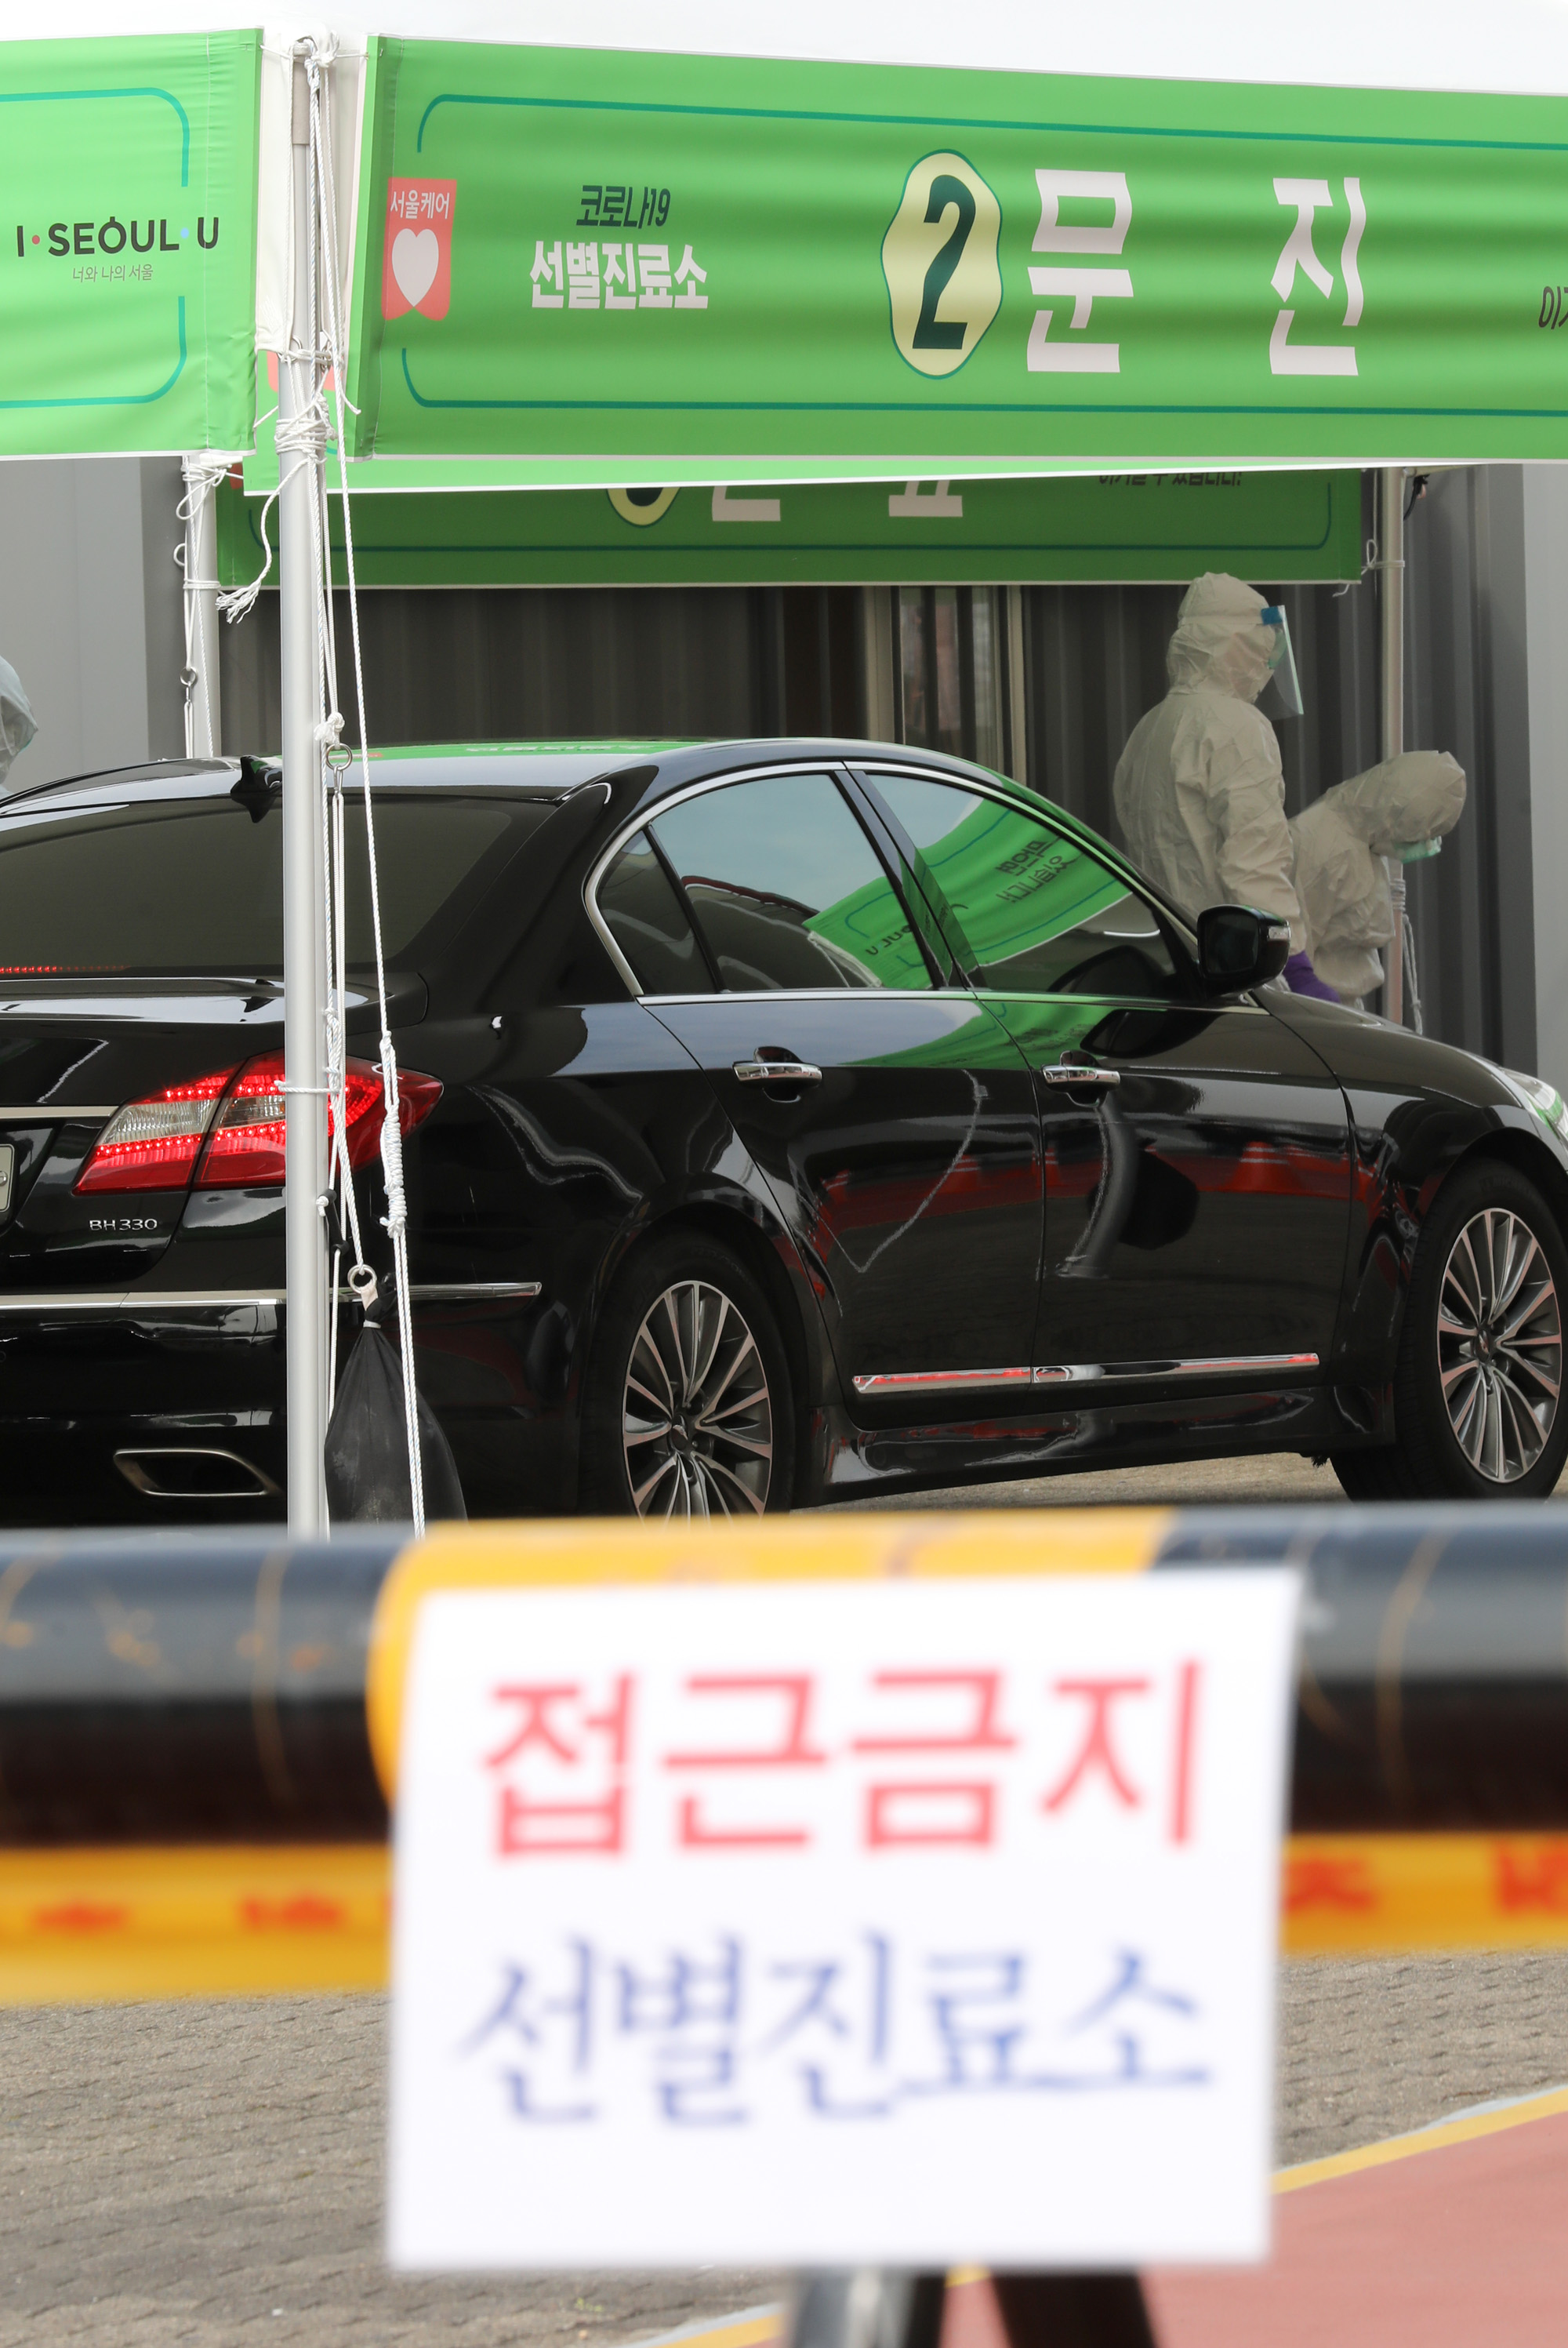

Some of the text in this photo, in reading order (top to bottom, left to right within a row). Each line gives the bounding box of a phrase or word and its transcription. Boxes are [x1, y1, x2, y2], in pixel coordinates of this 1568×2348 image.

[390, 189, 450, 220] 서울케어
[576, 184, 671, 229] 코로나19
[72, 264, 154, 283] 너와 나의 서울
[529, 240, 709, 309] 선별진료소
[912, 174, 976, 350] 2
[89, 1218, 158, 1231] BH330
[481, 1656, 1203, 1863] 접근금지
[455, 1928, 1214, 2128] 선별진료소
